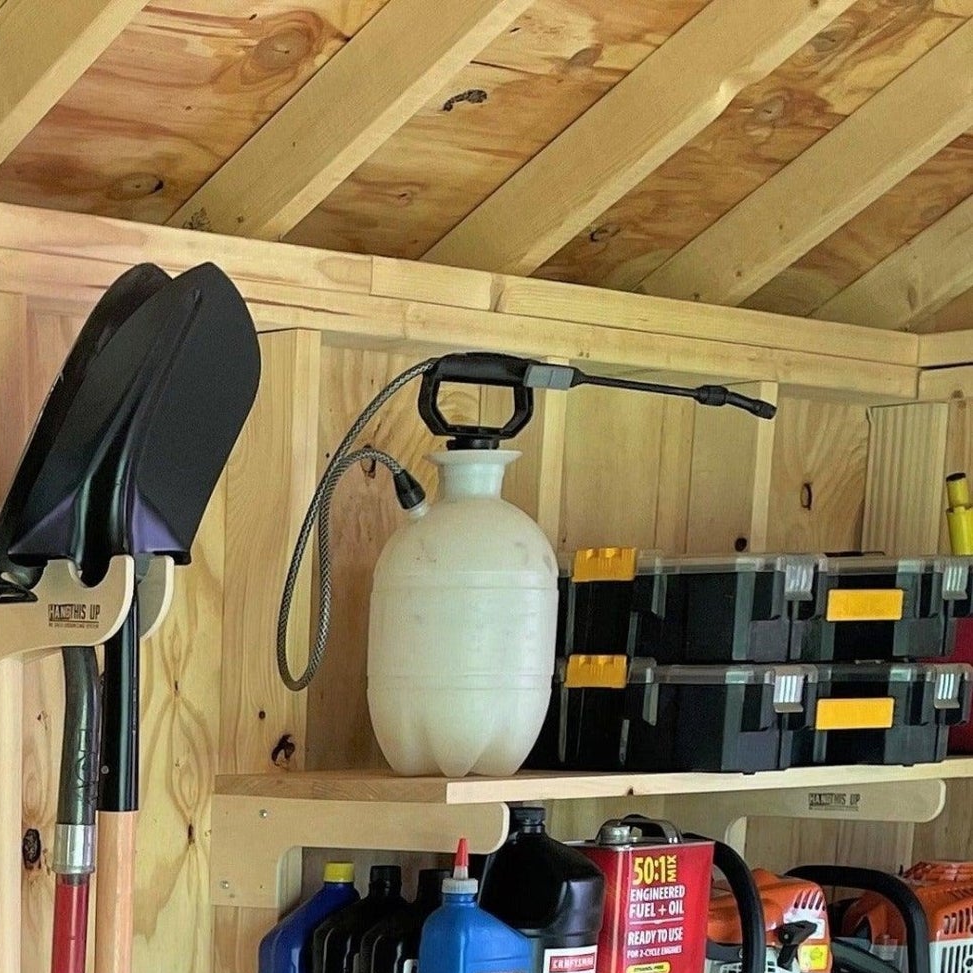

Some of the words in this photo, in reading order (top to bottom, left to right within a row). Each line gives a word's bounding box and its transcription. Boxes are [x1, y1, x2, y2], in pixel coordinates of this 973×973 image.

[632, 855, 666, 885] 50:1
[666, 855, 677, 882] MIX
[630, 885, 685, 902] ENGINEERED
[629, 902, 656, 918] FUEL
[668, 900, 684, 915] OIL
[628, 929, 656, 946] READY
[657, 928, 668, 942] TO
[668, 926, 684, 941] USE
[627, 949, 639, 959] FOR
